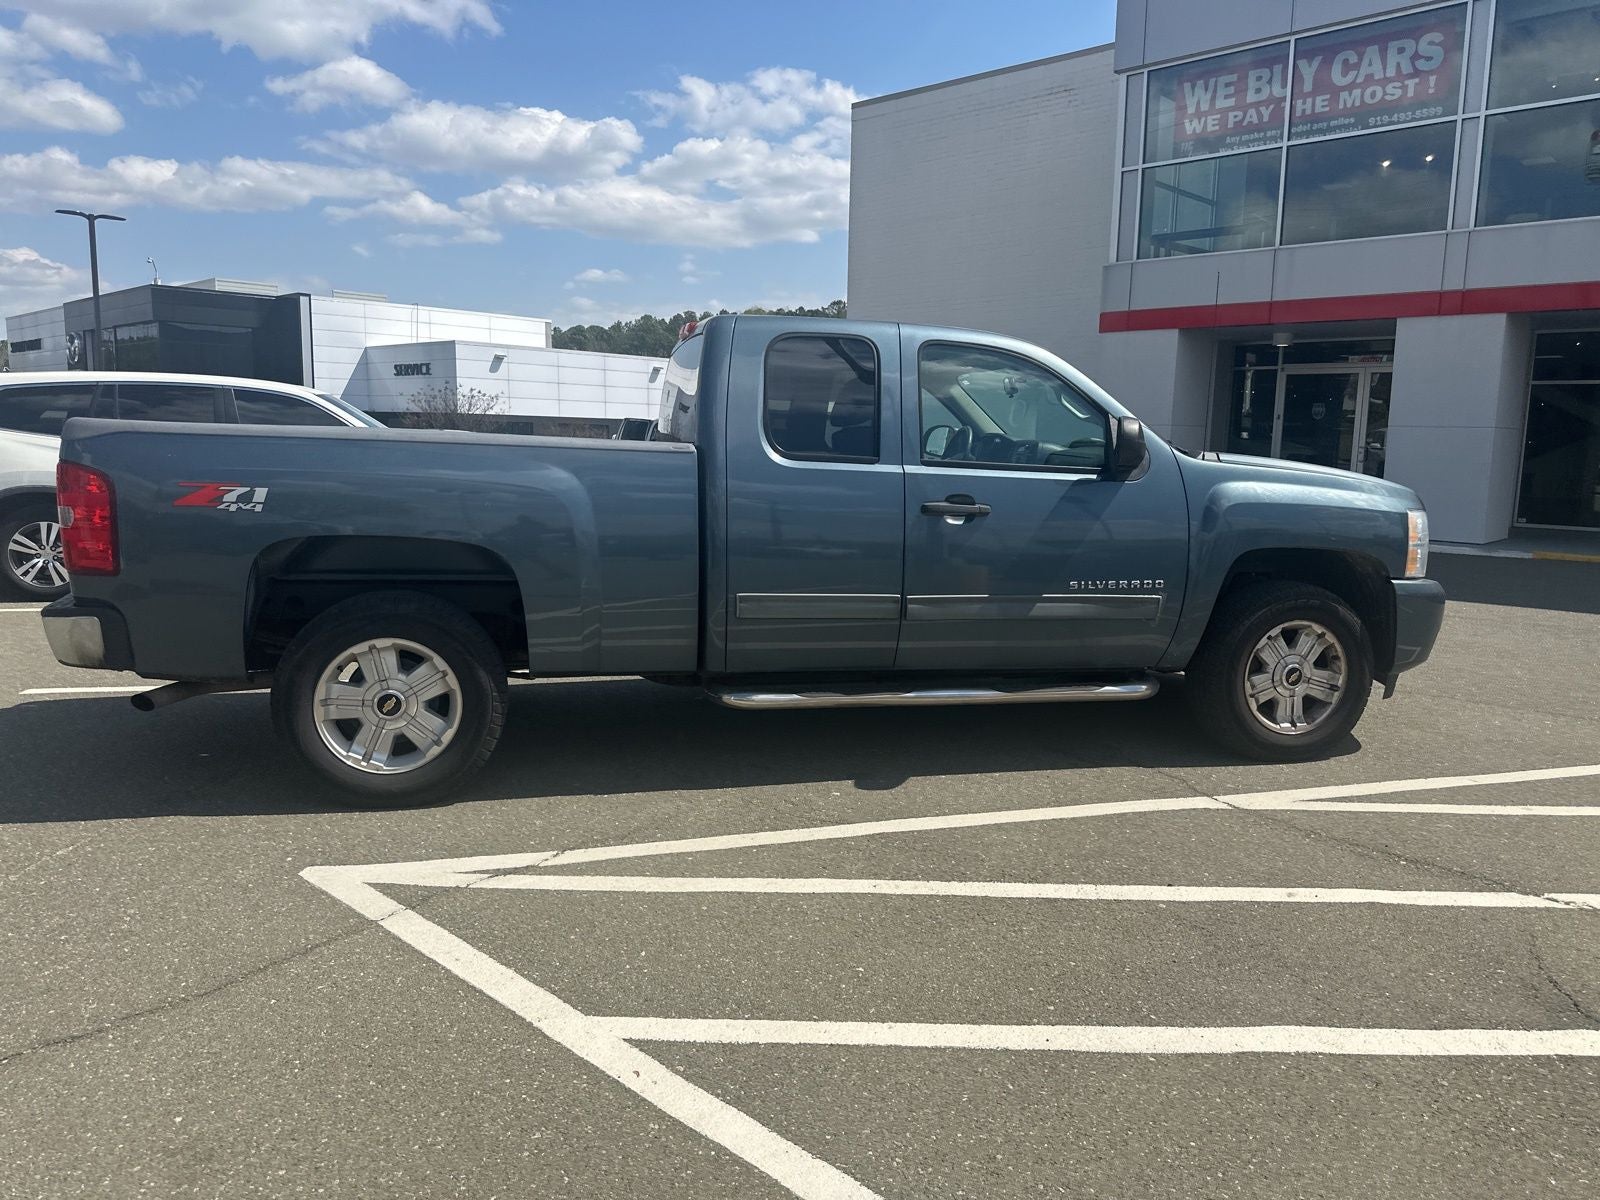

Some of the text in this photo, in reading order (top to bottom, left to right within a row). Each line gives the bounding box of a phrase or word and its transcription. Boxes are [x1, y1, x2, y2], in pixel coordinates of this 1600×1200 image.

[1183, 32, 1445, 114] WE BUY CARS
[1183, 114, 1220, 135] WE
[1227, 104, 1274, 128] PAY
[1339, 78, 1419, 109] MOST
[1225, 136, 1240, 145] Any
[1242, 132, 1264, 141] make
[1291, 123, 1311, 133] odel
[1330, 117, 1355, 127] miles
[393, 363, 432, 376] SERVICE
[173, 482, 269, 507] Z71
[1069, 580, 1164, 589] SILVERADO
